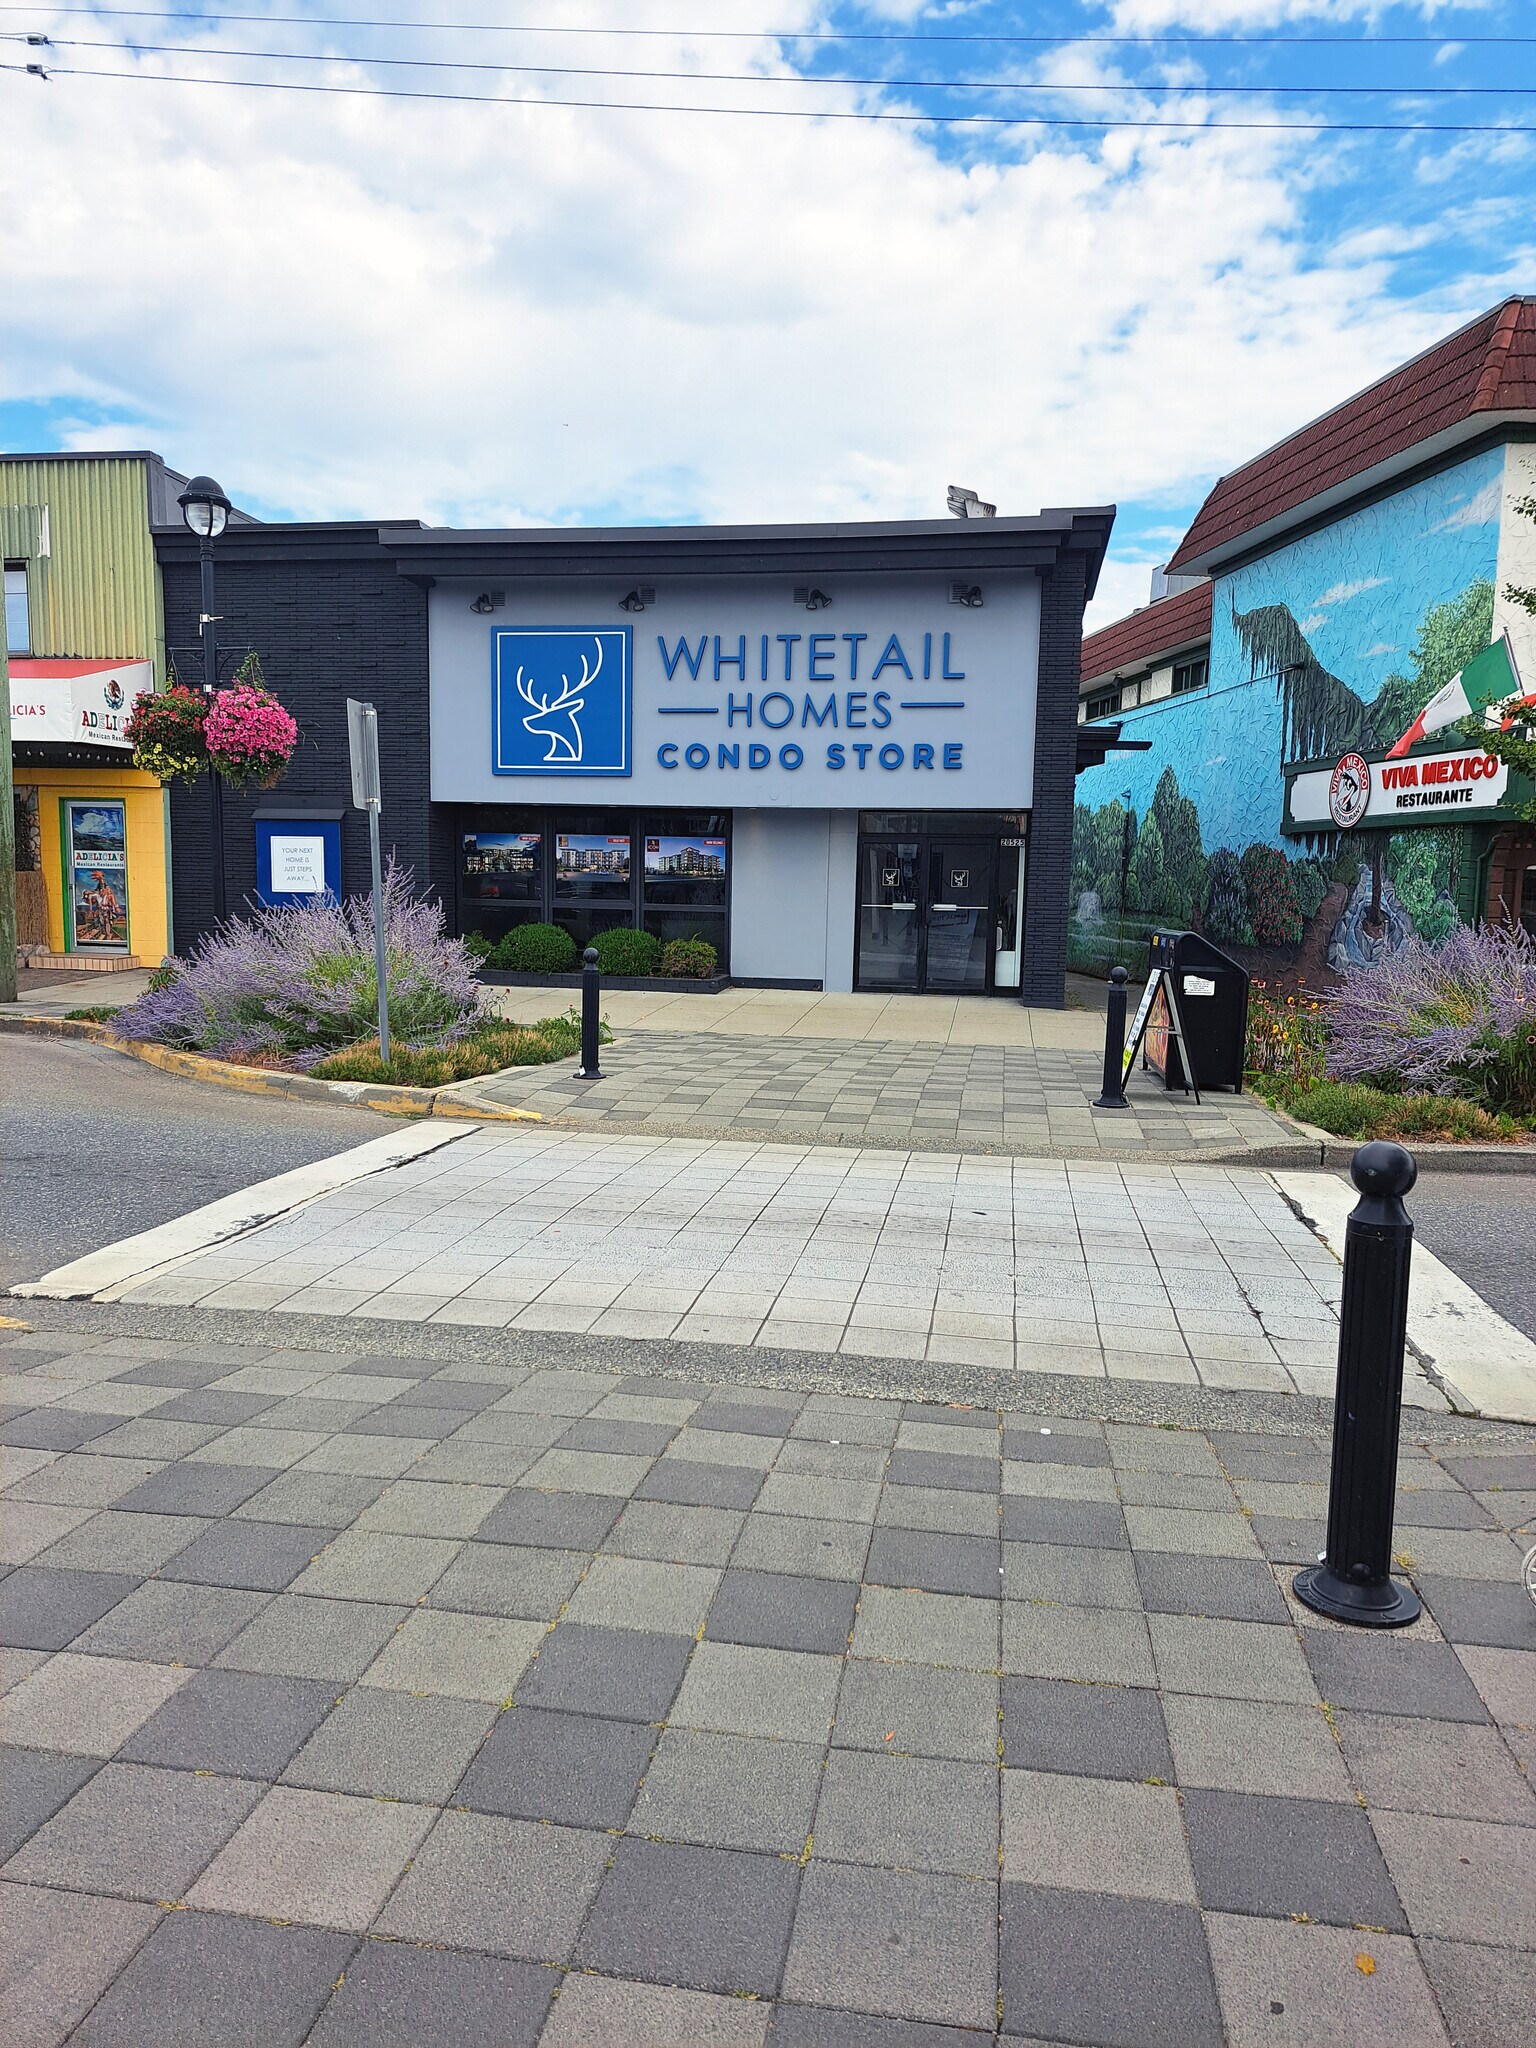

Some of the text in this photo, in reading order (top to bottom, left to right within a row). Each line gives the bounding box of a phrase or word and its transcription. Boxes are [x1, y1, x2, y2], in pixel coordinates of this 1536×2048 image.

[657, 632, 966, 681] WHITETAIL
[10, 704, 46, 716] ICIA'S
[727, 690, 892, 730] HOMES
[88, 730, 111, 740] Mexican
[657, 742, 964, 770] CONDO STORE
[1331, 756, 1368, 794] VIVA MEXICO
[1381, 753, 1499, 790] VIVA MEXICO
[1396, 787, 1474, 808] RESTAURANTE
[1001, 838, 1025, 846] 20525
[76, 852, 124, 861] ADELICIA'S
